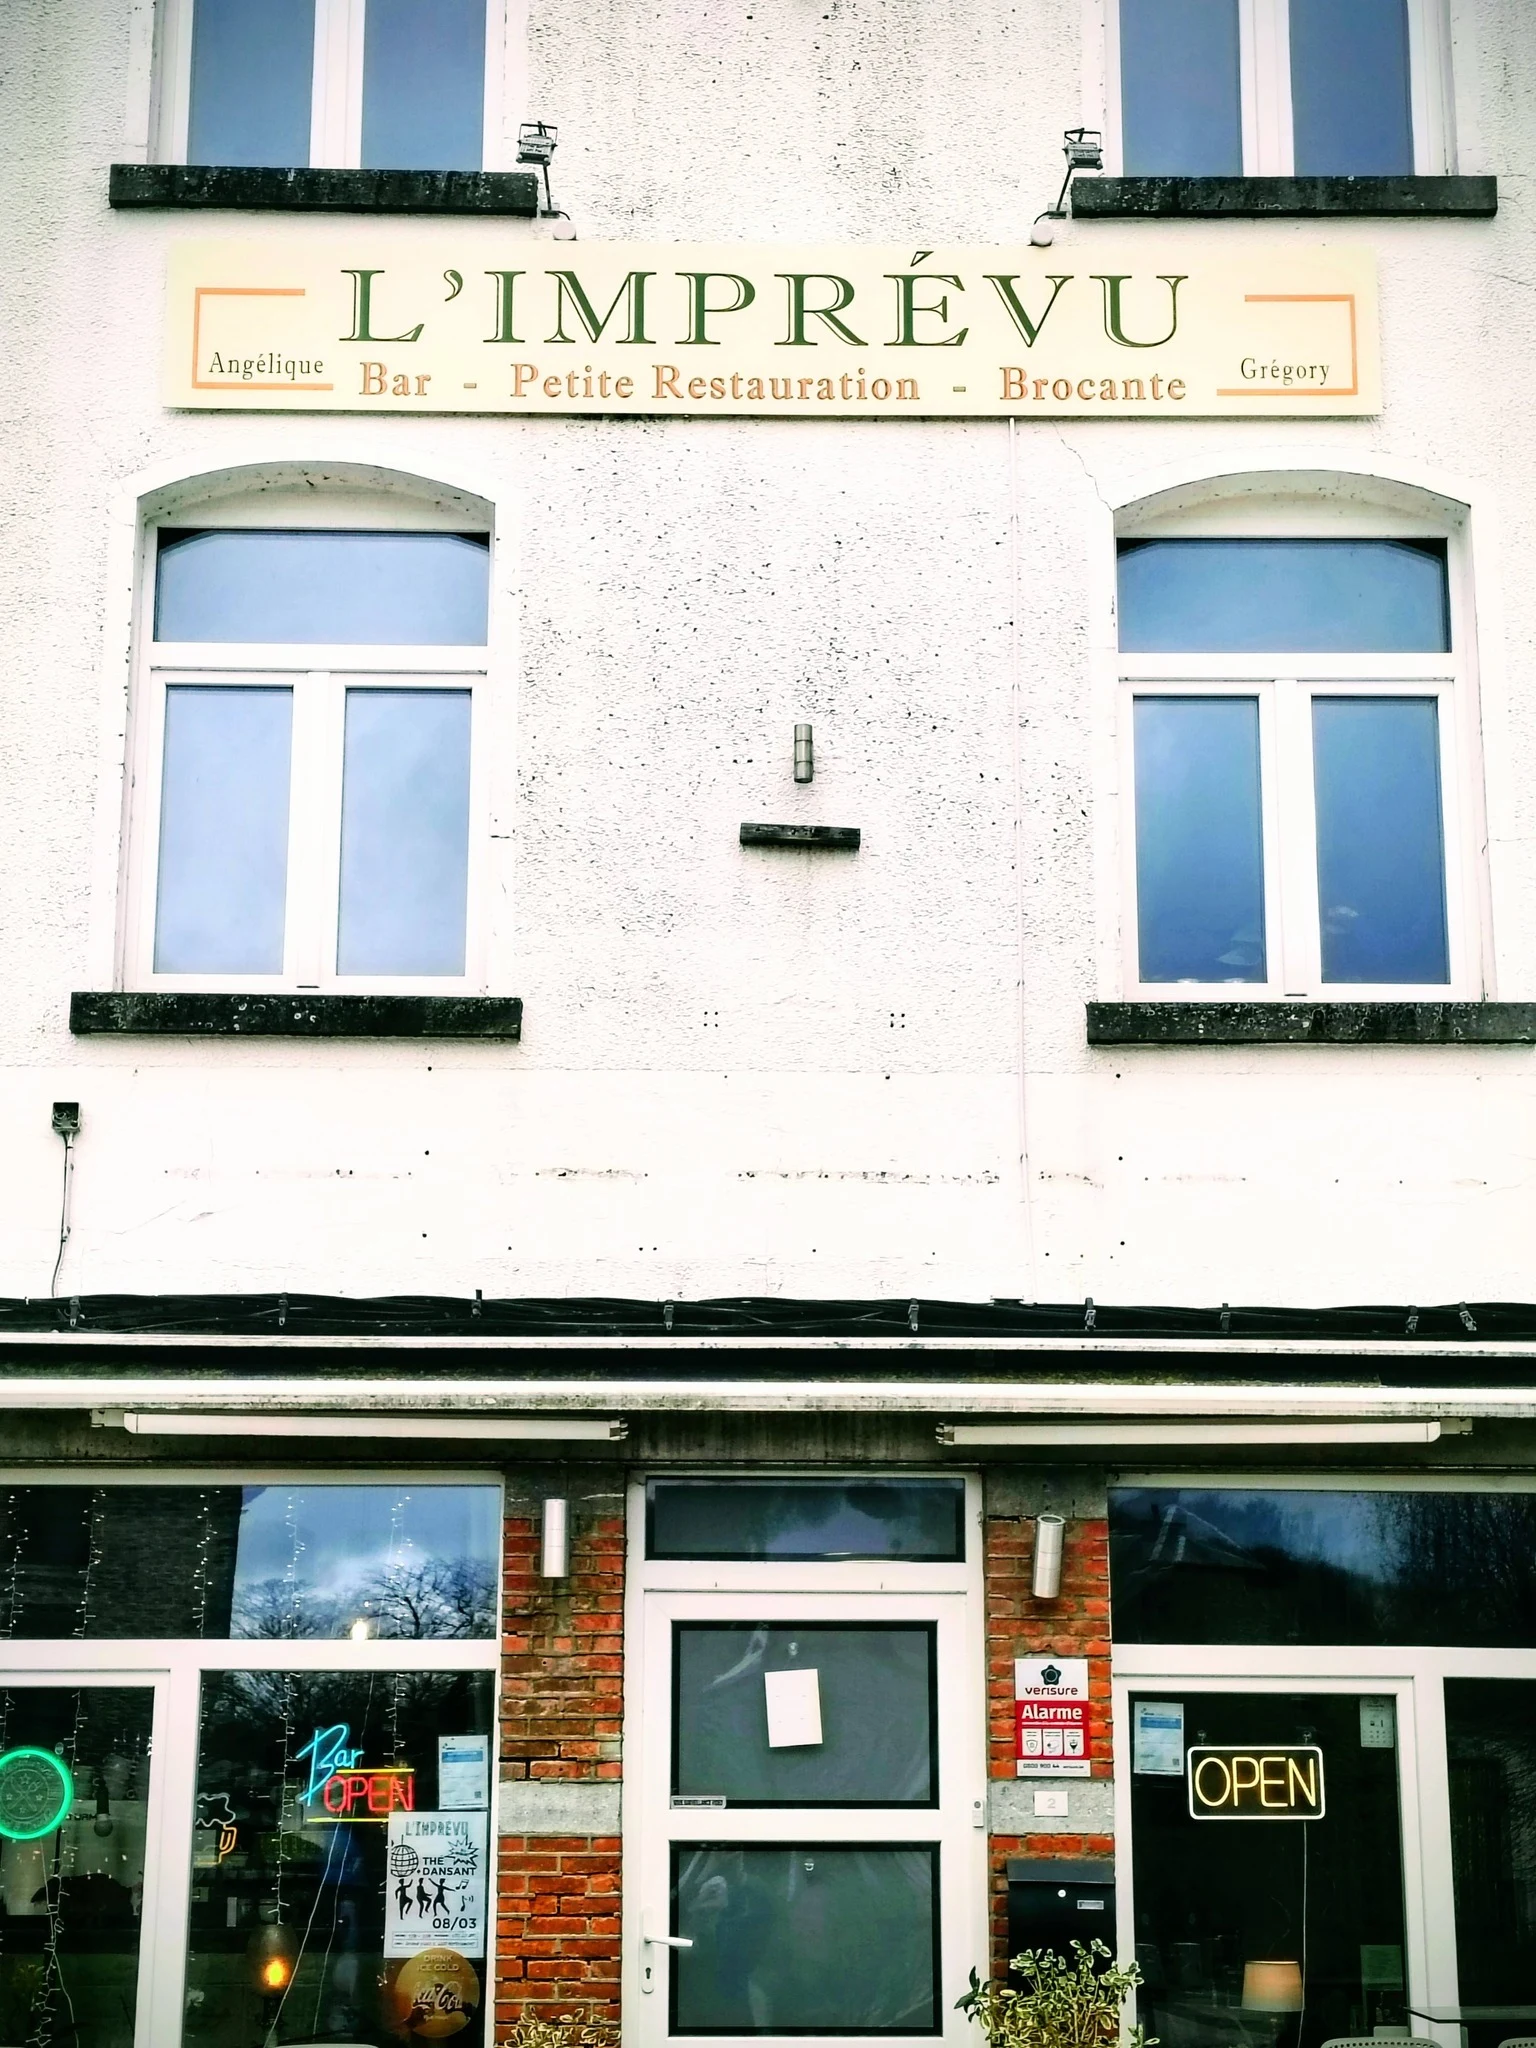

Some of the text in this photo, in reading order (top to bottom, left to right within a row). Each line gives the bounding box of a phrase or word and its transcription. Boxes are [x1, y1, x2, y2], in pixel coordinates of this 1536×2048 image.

[339, 250, 1189, 349] L'IMPRÉVU
[208, 351, 325, 381] Angélique
[1240, 357, 1331, 386] Grégory
[359, 361, 432, 397] Bar
[510, 362, 634, 399] Petite
[651, 364, 921, 401] Restauration
[952, 385, 967, 393] -
[999, 366, 1187, 402] Brocante
[1025, 1686, 1079, 1696] verisure
[1021, 1704, 1083, 1720] Alarme
[296, 1723, 366, 1808] Bar
[1194, 1756, 1317, 1808] OPEN
[323, 1774, 416, 1813] OPEN
[1046, 1797, 1057, 1809] 2
[422, 1867, 477, 1876] DANSANT
[432, 1917, 477, 1930] 08/03
[417, 1963, 460, 1972] ICE COLD
[423, 1954, 453, 1963] DRINK
